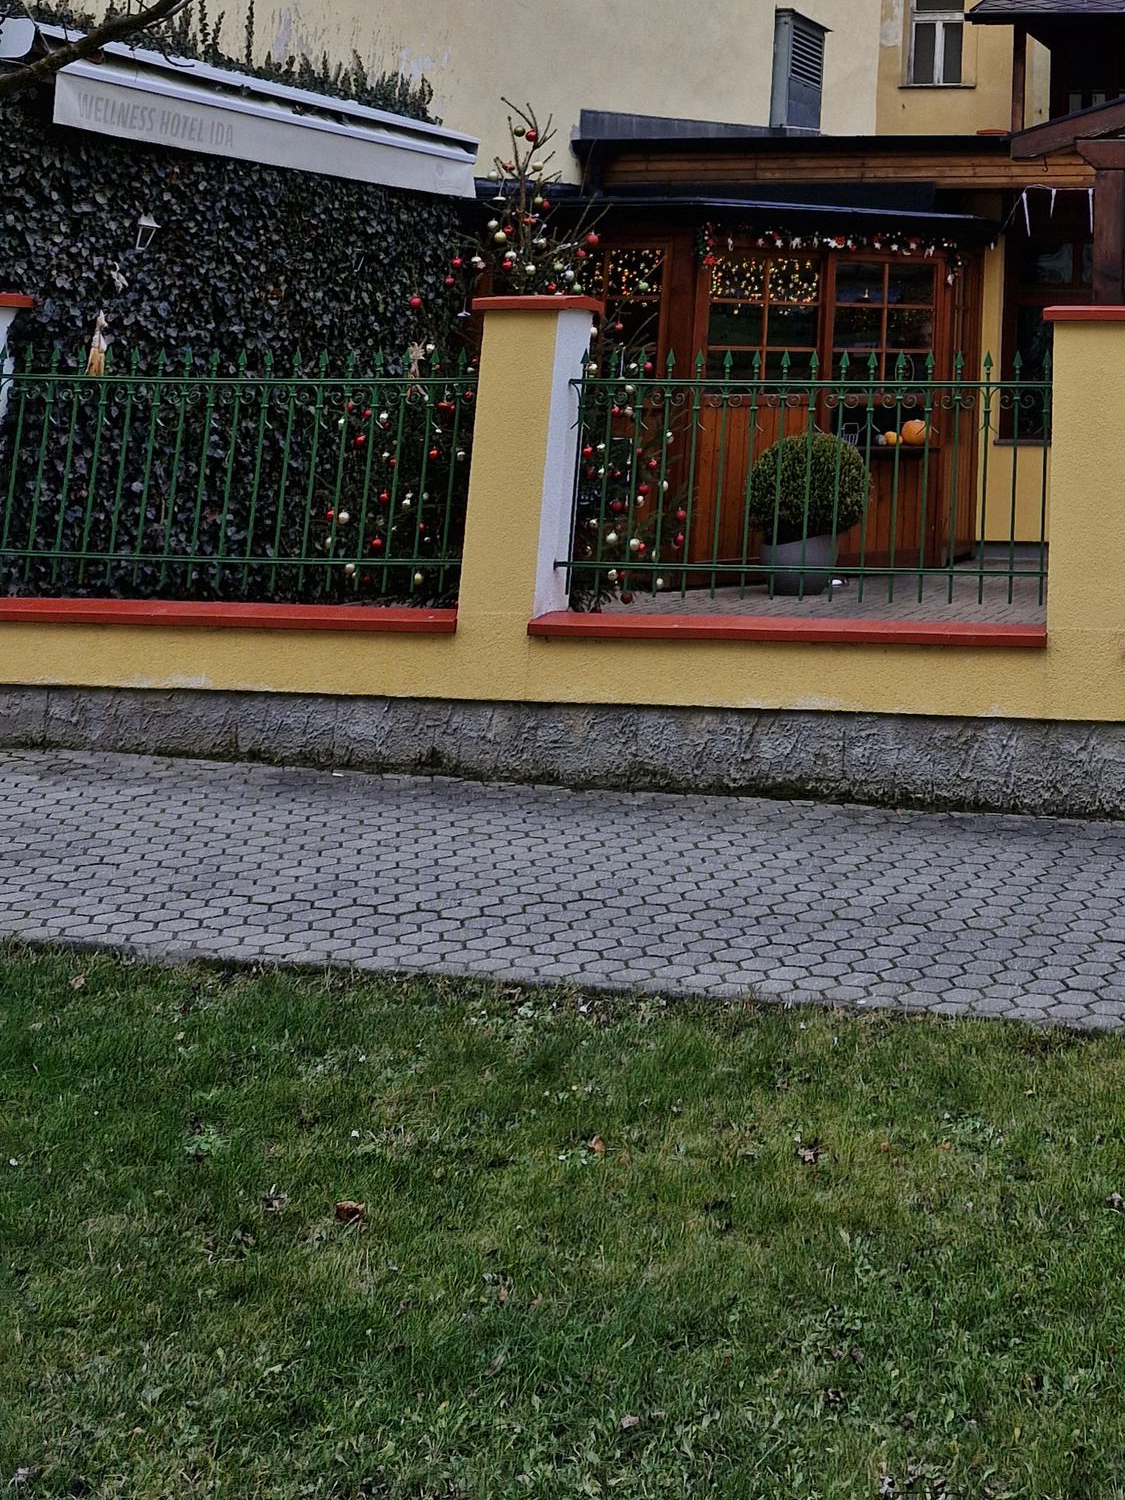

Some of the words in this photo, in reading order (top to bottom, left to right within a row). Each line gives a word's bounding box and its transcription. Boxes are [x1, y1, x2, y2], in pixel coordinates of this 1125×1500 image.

[78, 92, 155, 132] WELLNESS
[160, 110, 203, 143] HOTEL
[210, 121, 233, 148] IDA
